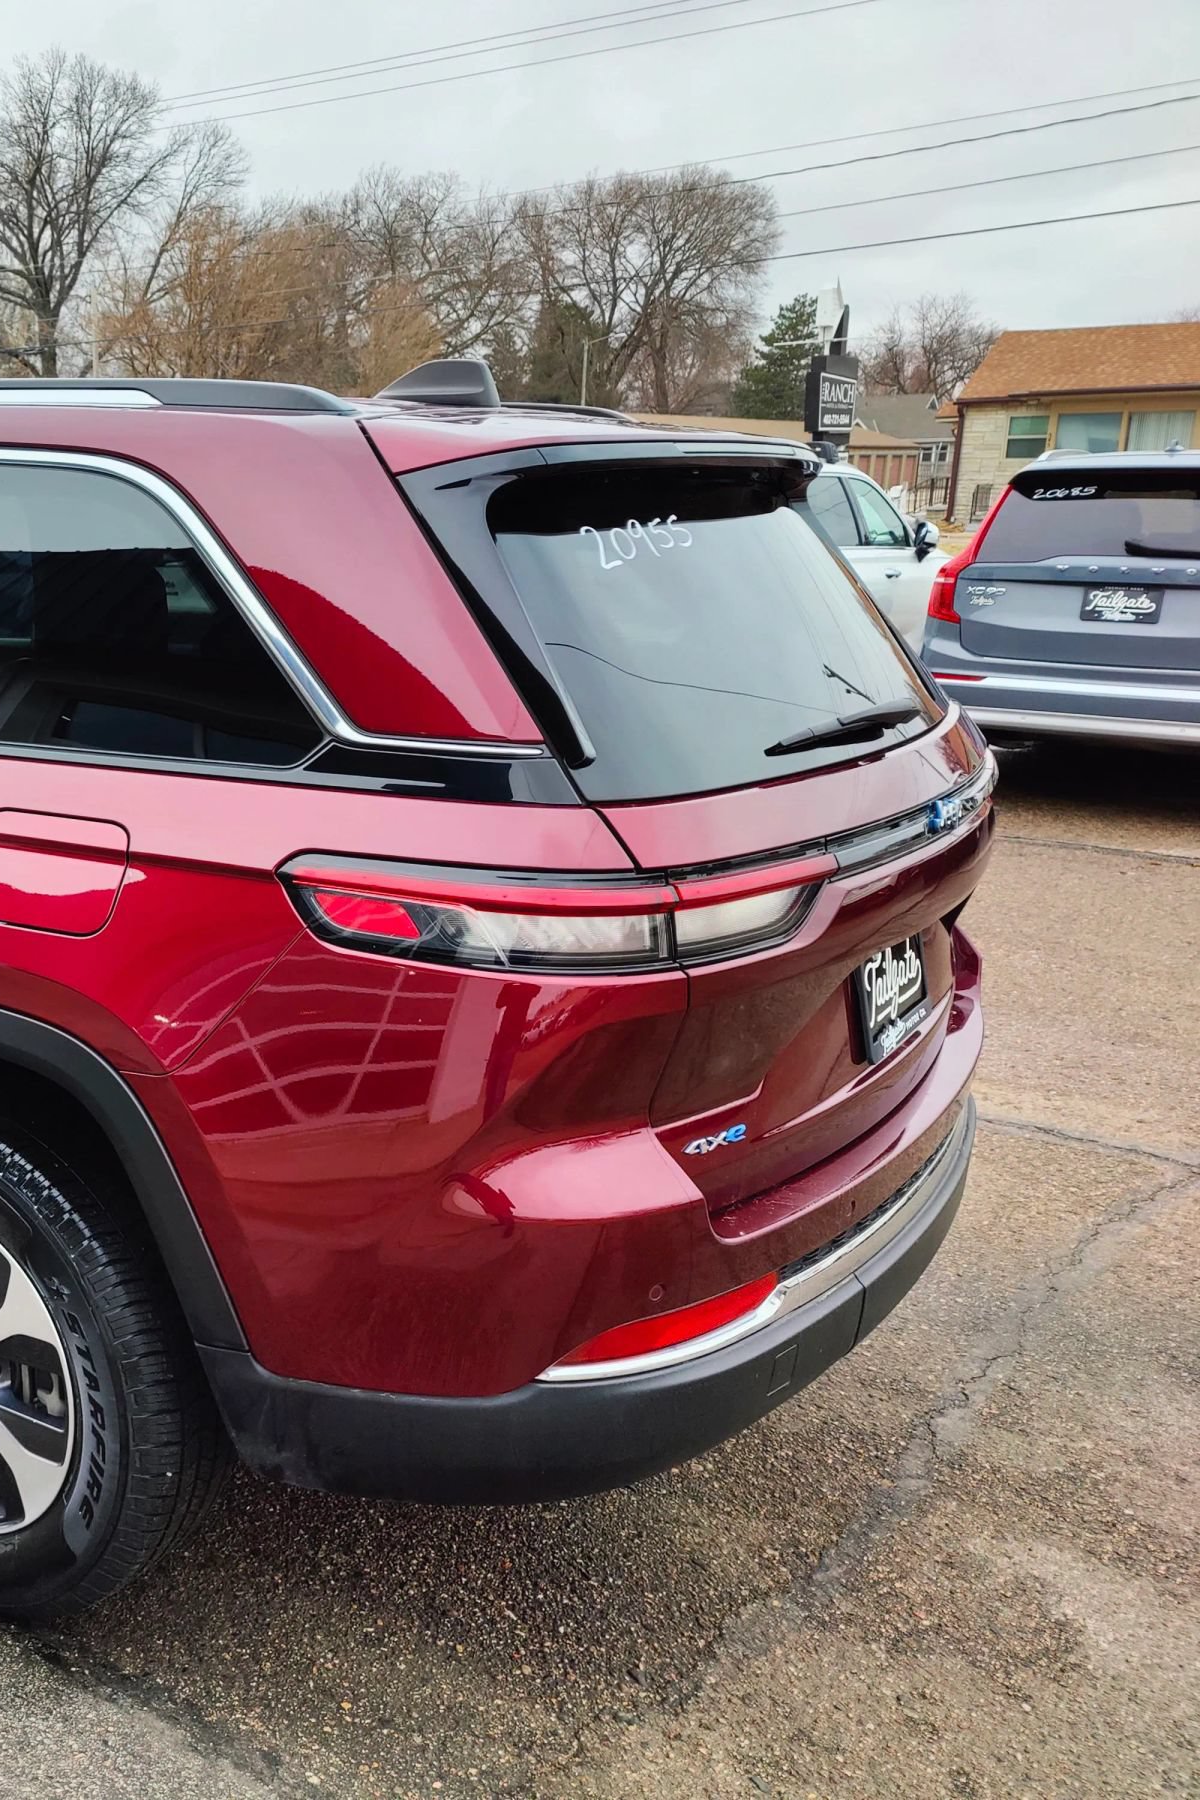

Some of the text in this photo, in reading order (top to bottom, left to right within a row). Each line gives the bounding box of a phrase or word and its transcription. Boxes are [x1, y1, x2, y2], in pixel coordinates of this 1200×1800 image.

[824, 382, 855, 403] RANCH
[1032, 486, 1098, 500] 20685
[580, 514, 693, 569] 20955
[1085, 590, 1156, 613] Tailgate
[864, 938, 921, 1028] Tailgate
[61, 1308, 107, 1531] STARFIRE
